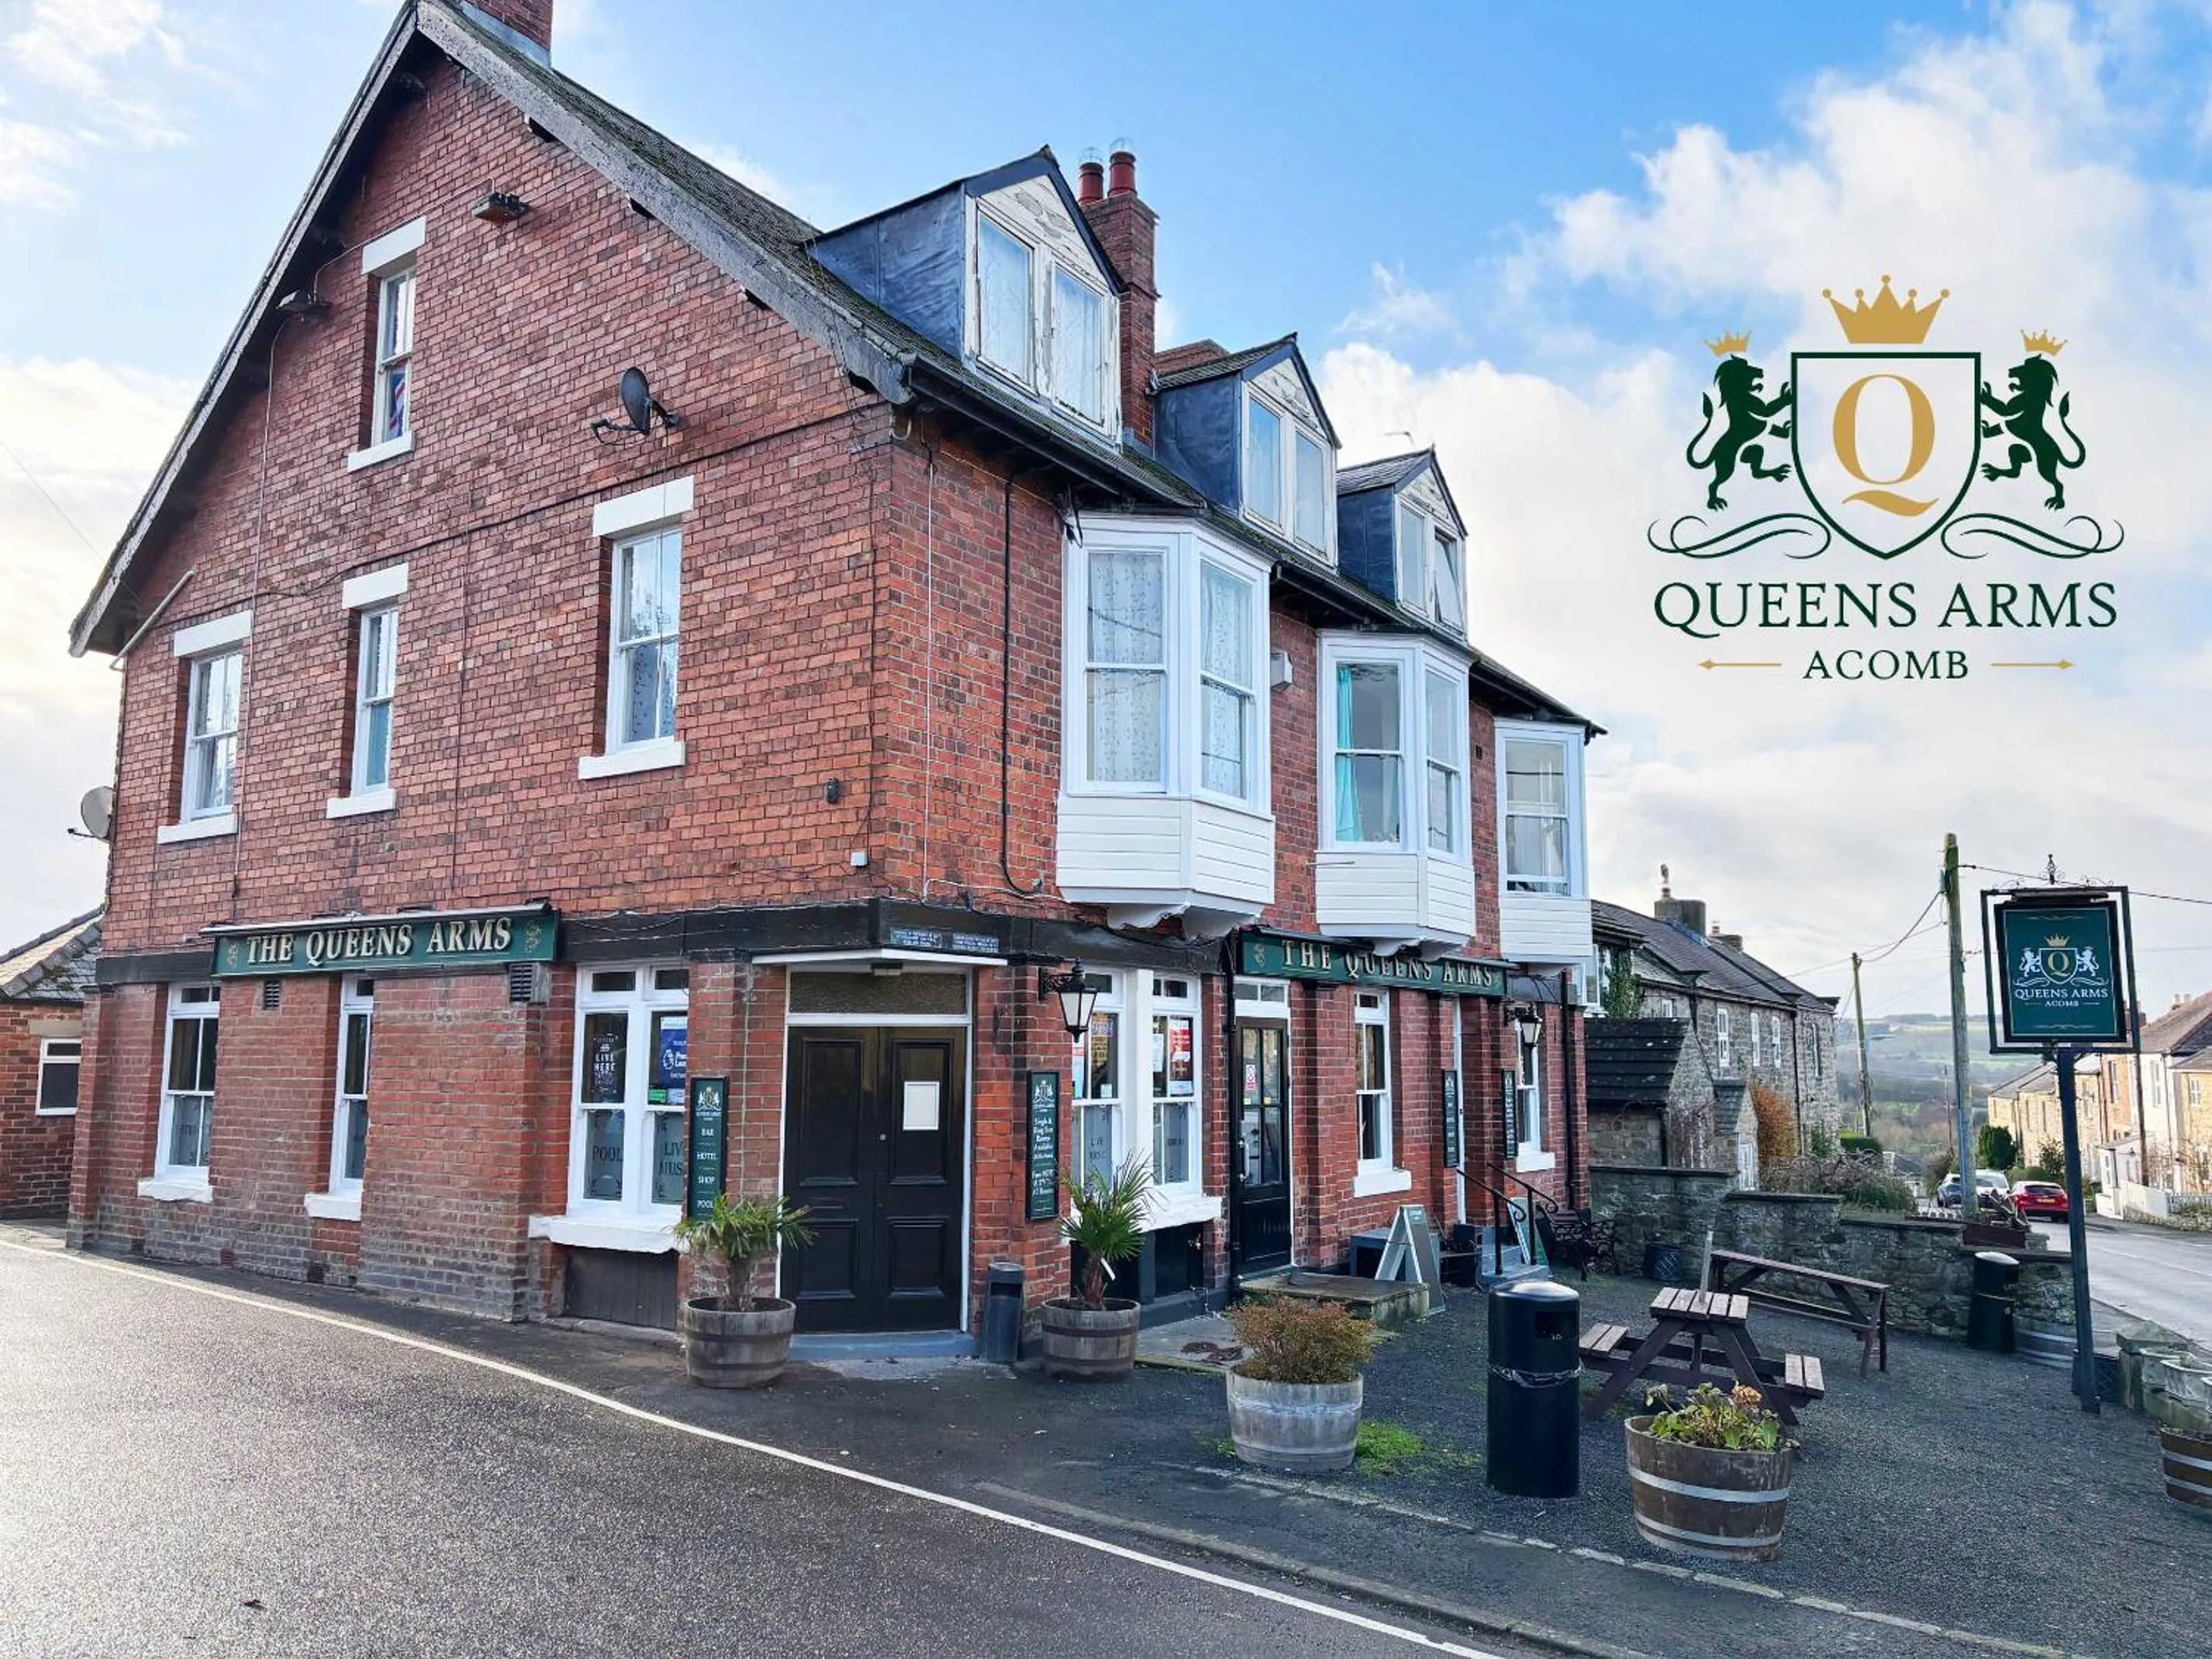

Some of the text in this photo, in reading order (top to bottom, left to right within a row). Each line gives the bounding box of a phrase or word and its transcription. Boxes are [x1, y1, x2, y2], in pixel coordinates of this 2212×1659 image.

[247, 917, 512, 966] THE QUEENS ARMS
[1282, 940, 1332, 969] THE
[1443, 961, 1492, 986] ARMS
[2048, 951, 2070, 978] Q
[2015, 988, 2108, 1000] QUEENS ARMS
[701, 1128, 714, 1136] BAR
[592, 1146, 623, 1161] POOL
[664, 1142, 684, 1156] LIV
[697, 1200, 713, 1209] POOL
